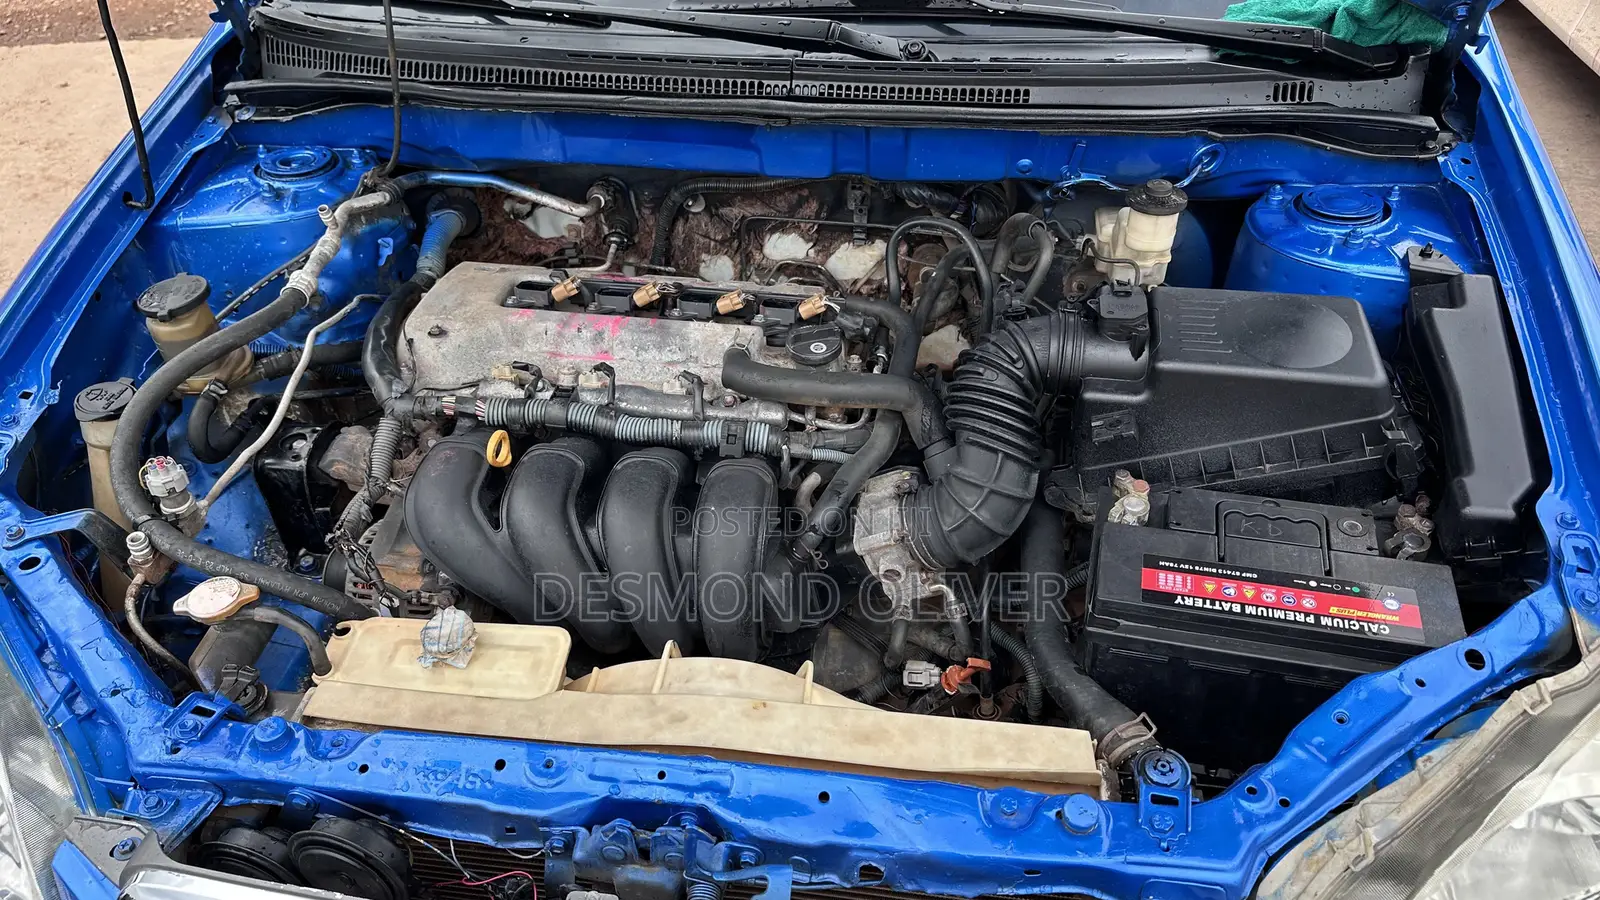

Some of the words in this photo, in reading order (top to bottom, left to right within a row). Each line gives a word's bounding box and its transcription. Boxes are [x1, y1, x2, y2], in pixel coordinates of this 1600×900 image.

[1174, 595, 1241, 613] BATTERY
[1245, 605, 1315, 624] PREMIUM
[1356, 610, 1400, 621] WRANGLER
[1320, 616, 1390, 634] CALCIUM
